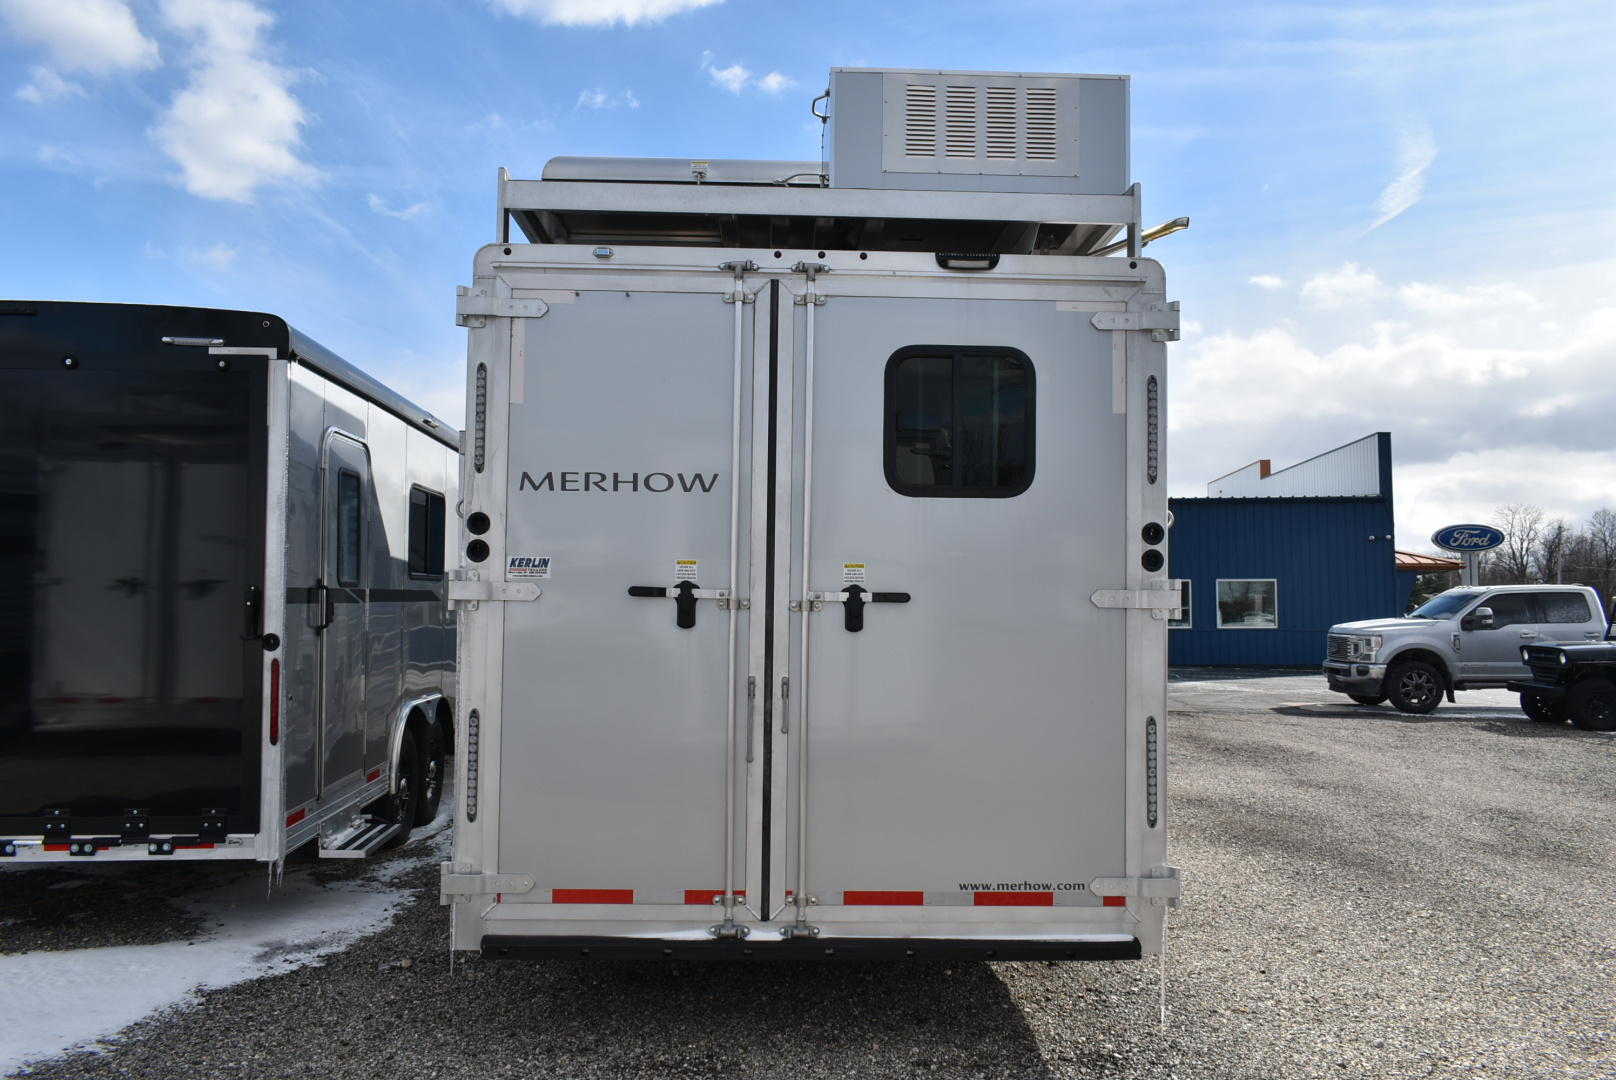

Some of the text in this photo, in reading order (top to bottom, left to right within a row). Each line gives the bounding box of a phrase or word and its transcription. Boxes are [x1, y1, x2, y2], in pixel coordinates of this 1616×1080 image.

[519, 471, 719, 493] MERHOW
[1450, 530, 1491, 546] Ford
[509, 557, 550, 568] KERLIN
[959, 881, 1085, 891] www.merhow.com
